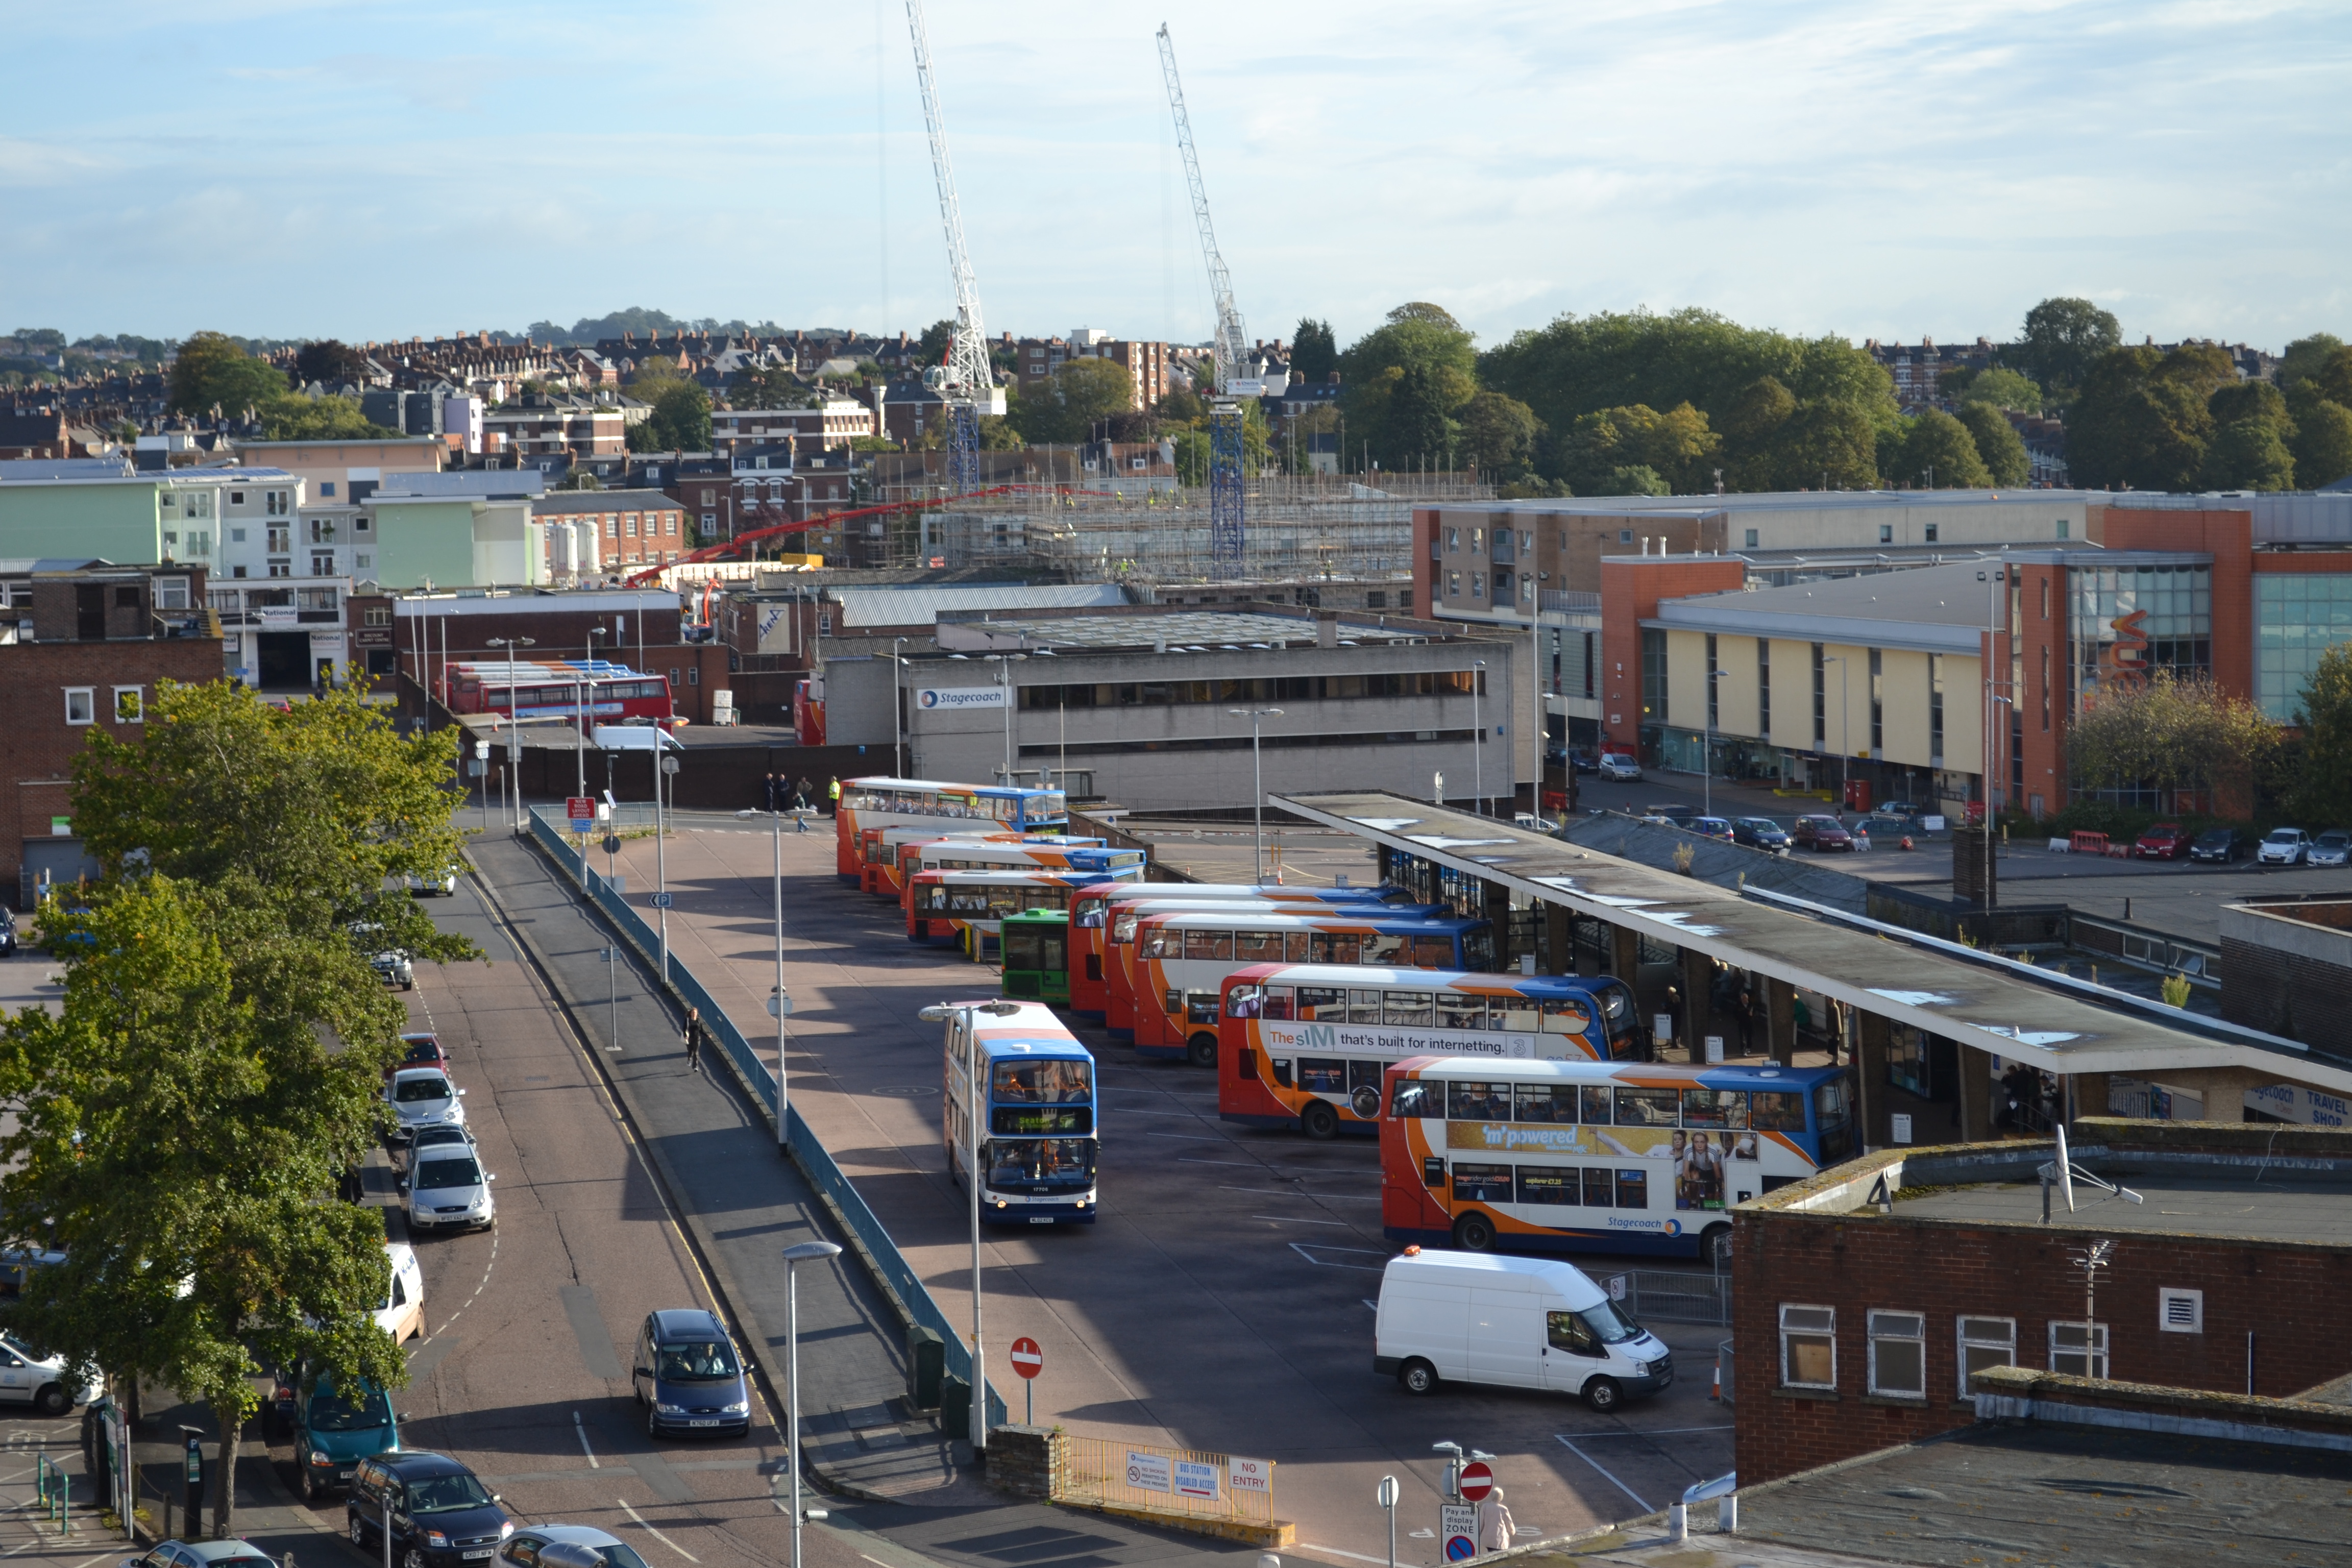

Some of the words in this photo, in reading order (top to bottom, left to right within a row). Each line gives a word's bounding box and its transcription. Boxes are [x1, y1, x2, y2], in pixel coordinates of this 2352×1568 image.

[941, 693, 1001, 705] Stagecoach
[1270, 1032, 1294, 1044] The
[1340, 1034, 1374, 1045] that’s
[1378, 1035, 1405, 1047] built
[1408, 1038, 1426, 1048] for
[1429, 1038, 1505, 1055] internetting.
[2307, 1091, 2348, 1115] TRAVEL
[2313, 1110, 2342, 1126] SHOP
[1608, 1217, 1661, 1229] Stagecoach
[1180, 1463, 1190, 1473] BUS
[1191, 1465, 1210, 1476] STATION
[1242, 1463, 1256, 1473] NO
[1175, 1476, 1197, 1487] DISABLED
[1199, 1480, 1215, 1489] ACCESS
[1233, 1476, 1265, 1488] ENTRY
[1446, 1508, 1459, 1516] Pay
[1447, 1516, 1473, 1525] display
[1446, 1525, 1474, 1533] ZONE
